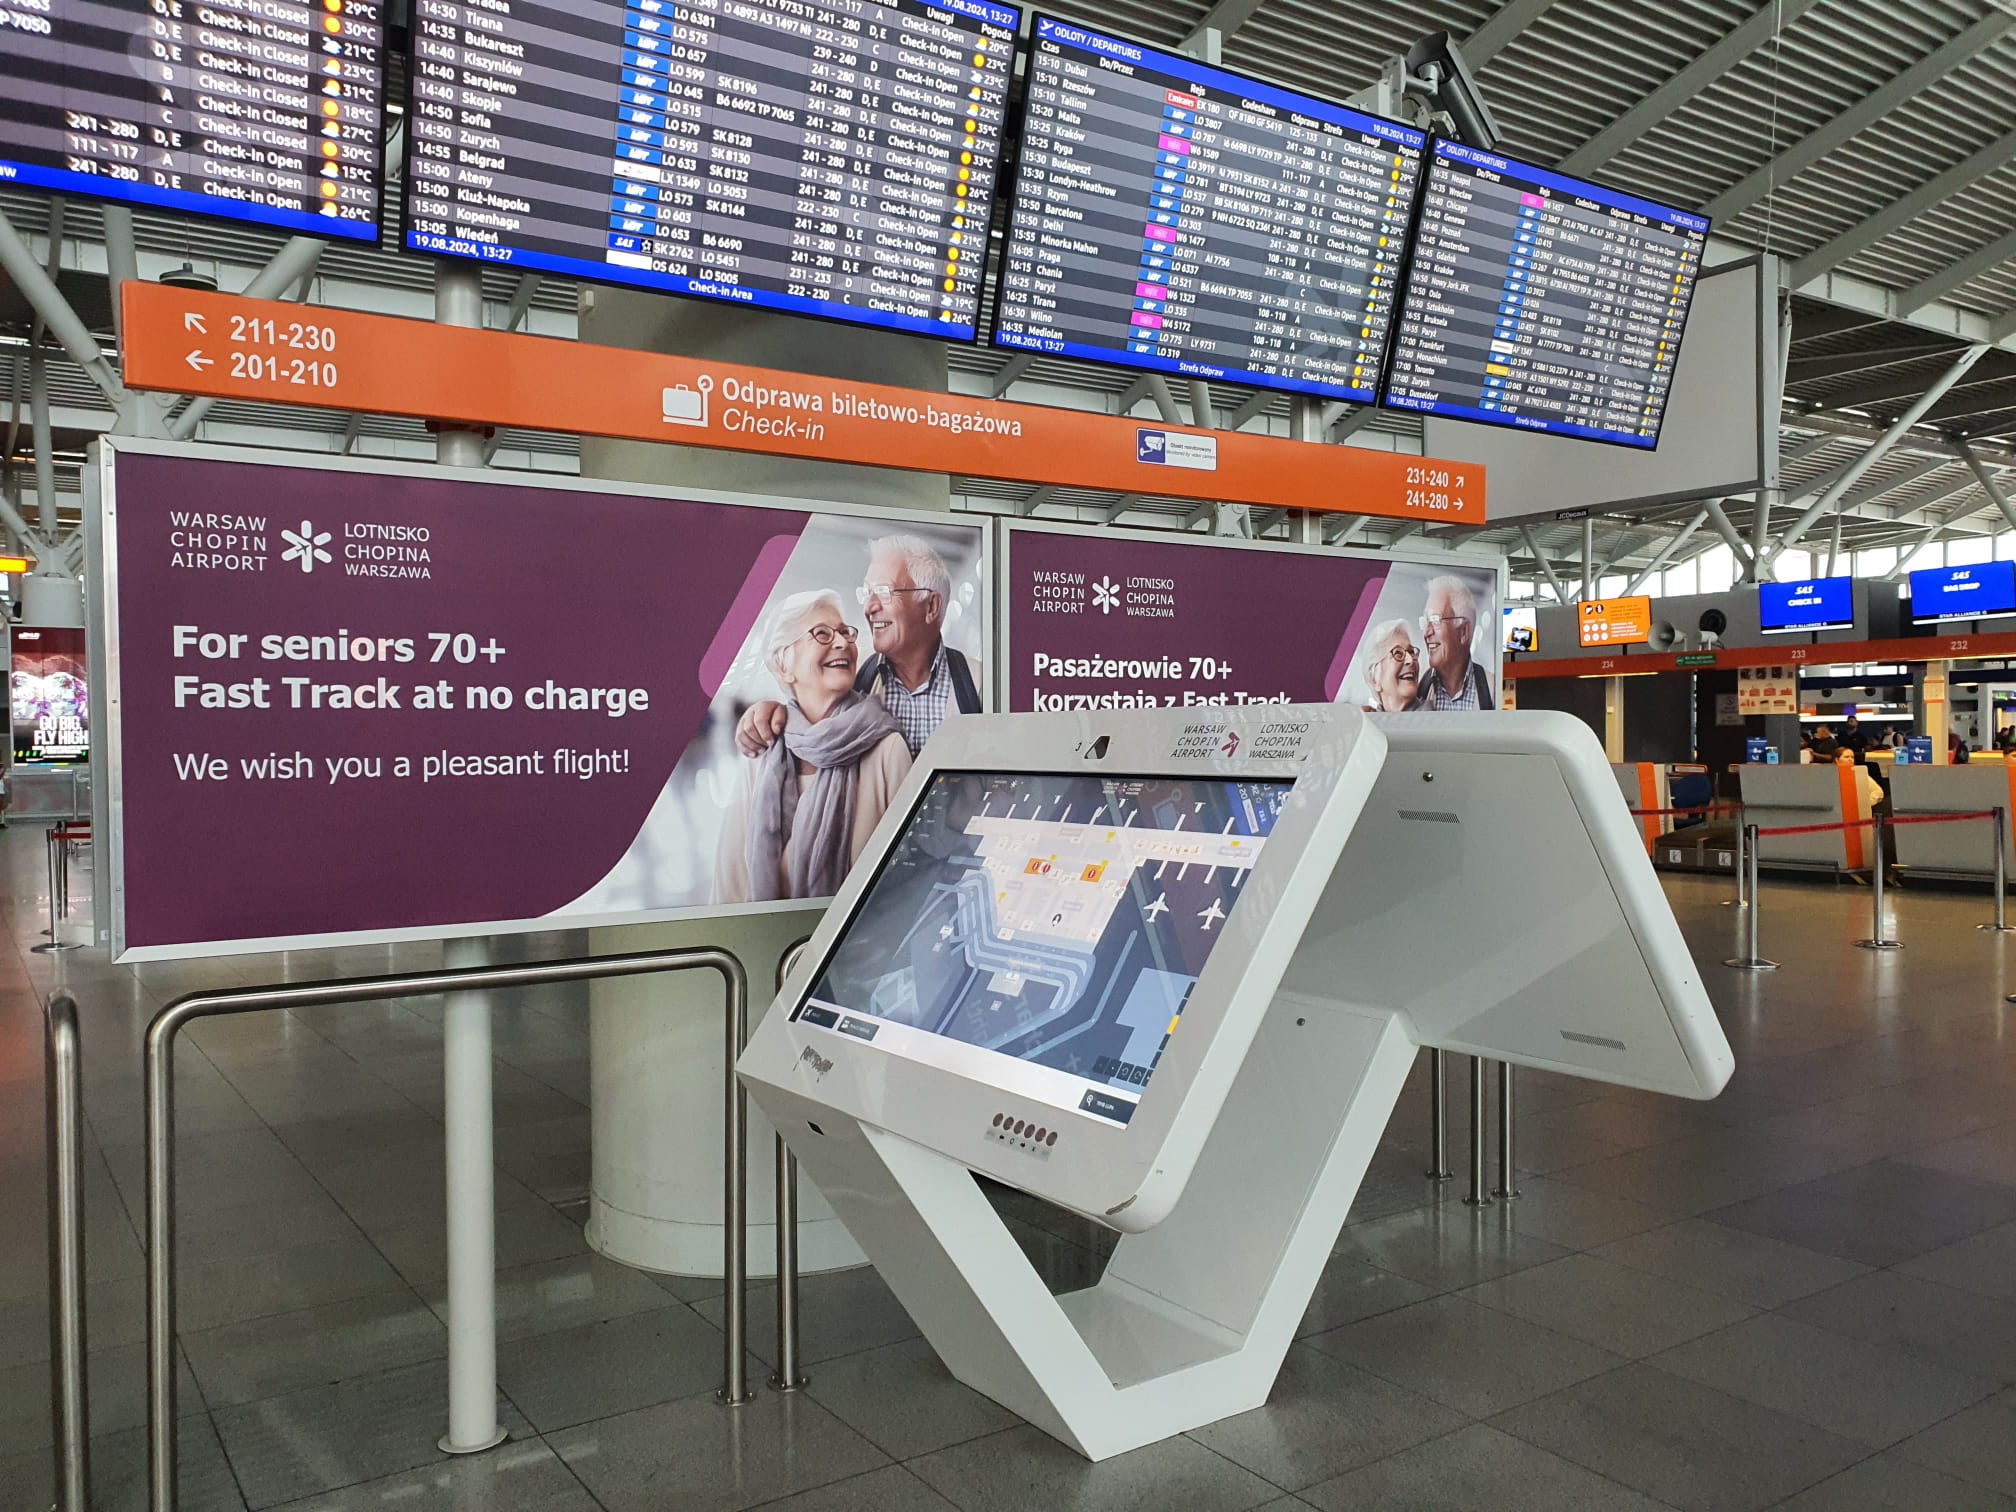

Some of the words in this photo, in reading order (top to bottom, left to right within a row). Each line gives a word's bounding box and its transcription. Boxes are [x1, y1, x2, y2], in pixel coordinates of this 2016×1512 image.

[423, 0, 457, 19] 14:30
[466, 10, 503, 31] Tirana
[670, 63, 684, 76] LO
[685, 66, 705, 81] 599
[981, 22, 1013, 41] Pogoda
[1054, 26, 1086, 43] ODLOTY
[1092, 37, 1141, 60] DEPARTURES
[422, 20, 455, 40] 14:35
[465, 31, 523, 57] Bukareszt
[668, 81, 682, 94] LO
[683, 85, 703, 99] 645
[1041, 40, 1059, 54] Czas
[1099, 56, 1133, 75] Do/Przez
[1190, 83, 1205, 96] Rejs
[462, 71, 516, 94] Sarajewo
[1038, 55, 1060, 69] 15:10
[1064, 62, 1087, 77] Dubai
[1207, 103, 1220, 114] 180
[162, 65, 173, 80] B
[263, 88, 307, 108] Closed
[343, 105, 373, 122] 18°C
[462, 91, 501, 111] Skopje
[1060, 94, 1086, 110] Tallinn
[162, 87, 173, 102] A
[262, 109, 307, 129] Closed
[342, 125, 372, 142] 27°C
[419, 101, 452, 119] 14:50
[461, 111, 491, 128] Sofia
[1058, 110, 1080, 124] Malta
[162, 110, 172, 123] C
[262, 130, 306, 150] Closed
[341, 145, 372, 162] 30°C
[1027, 135, 1048, 148] 15:25
[1053, 141, 1073, 155] Ryga
[460, 130, 499, 149] Zurych
[659, 171, 674, 184] LX
[676, 174, 700, 189] 1349
[1051, 157, 1091, 175] Budapeszt
[162, 153, 173, 166] A
[267, 172, 301, 190] Open
[341, 185, 371, 201] 21°C
[458, 169, 492, 188] Ateny
[417, 141, 450, 158] 14:55
[459, 149, 504, 169] Belgrad
[914, 241, 936, 254] Open
[960, 250, 979, 263] 32°C
[1049, 172, 1116, 196] Londyn-Heathrow
[1180, 203, 1190, 213] LO
[1190, 205, 1204, 216] 279
[266, 193, 301, 210] Open
[340, 205, 370, 221] 26°C
[1043, 219, 1063, 232] Delhi
[1045, 203, 1082, 220] Barcelona
[1189, 235, 1205, 246] 1477
[415, 200, 448, 216] 15:00
[456, 207, 519, 230] Kopenhaga
[654, 242, 668, 254] SK
[668, 245, 693, 259] 2762
[955, 297, 973, 309] 19°C
[1038, 249, 1060, 263] Praga
[415, 234, 478, 257] 19.08.2024,
[482, 245, 512, 260] 13:27
[731, 287, 752, 300] Area
[1036, 265, 1062, 278] Chania
[1030, 310, 1052, 322] Wilno
[231, 316, 335, 354] 211-230
[1028, 325, 1062, 339] Mediolan
[231, 347, 337, 387] 201-210
[1179, 362, 1198, 372] Strefa
[1199, 365, 1224, 376] Odpraw
[723, 378, 822, 412] Odprawa
[832, 390, 1026, 436] biletowo-bagażowa
[724, 406, 824, 440] Check-in
[1407, 468, 1448, 487] 231-240
[1407, 490, 1448, 509] 241-280
[171, 512, 265, 534] WARSAW
[345, 523, 429, 541] LOTNISKO
[171, 532, 265, 554] CHOPIN
[172, 552, 267, 570] AIRPORT
[345, 544, 430, 562] CHOPINA
[345, 564, 430, 578] WARSZAWA
[1034, 571, 1084, 588] WARSAW
[1034, 586, 1084, 598] CHOPIN
[1127, 577, 1173, 589] LOTNISKO
[1034, 601, 1084, 613] AIRPORT
[1127, 593, 1174, 604] CHOPINA
[1127, 607, 1174, 617] WARSZAWA
[174, 626, 247, 658] For
[262, 629, 414, 662] seniors
[429, 633, 505, 663] 70+
[1951, 640, 1968, 650] 232
[1791, 650, 1806, 659] 233
[1035, 653, 1181, 679] Pasażerowie
[1189, 658, 1232, 679] 70+
[175, 676, 270, 708] Fast
[282, 678, 401, 708] Track
[413, 681, 453, 709] at
[467, 687, 512, 709] no
[525, 680, 648, 717] charge
[39, 716, 58, 731] GO
[1184, 723, 1227, 735] WARSAW
[1260, 723, 1309, 734] LOTNISKO
[34, 730, 57, 745] FLY
[58, 730, 88, 745] HIGH
[1177, 736, 1220, 747] CHOPIN
[1254, 736, 1302, 747] CHOPINA
[1170, 748, 1215, 759] AIRPORT
[1248, 750, 1296, 759] WARSZAWA
[174, 754, 227, 780] We
[241, 752, 312, 779] wish
[326, 758, 380, 784] you
[394, 757, 409, 776] a
[424, 750, 544, 782] pleasant
[554, 749, 628, 779] flight!
